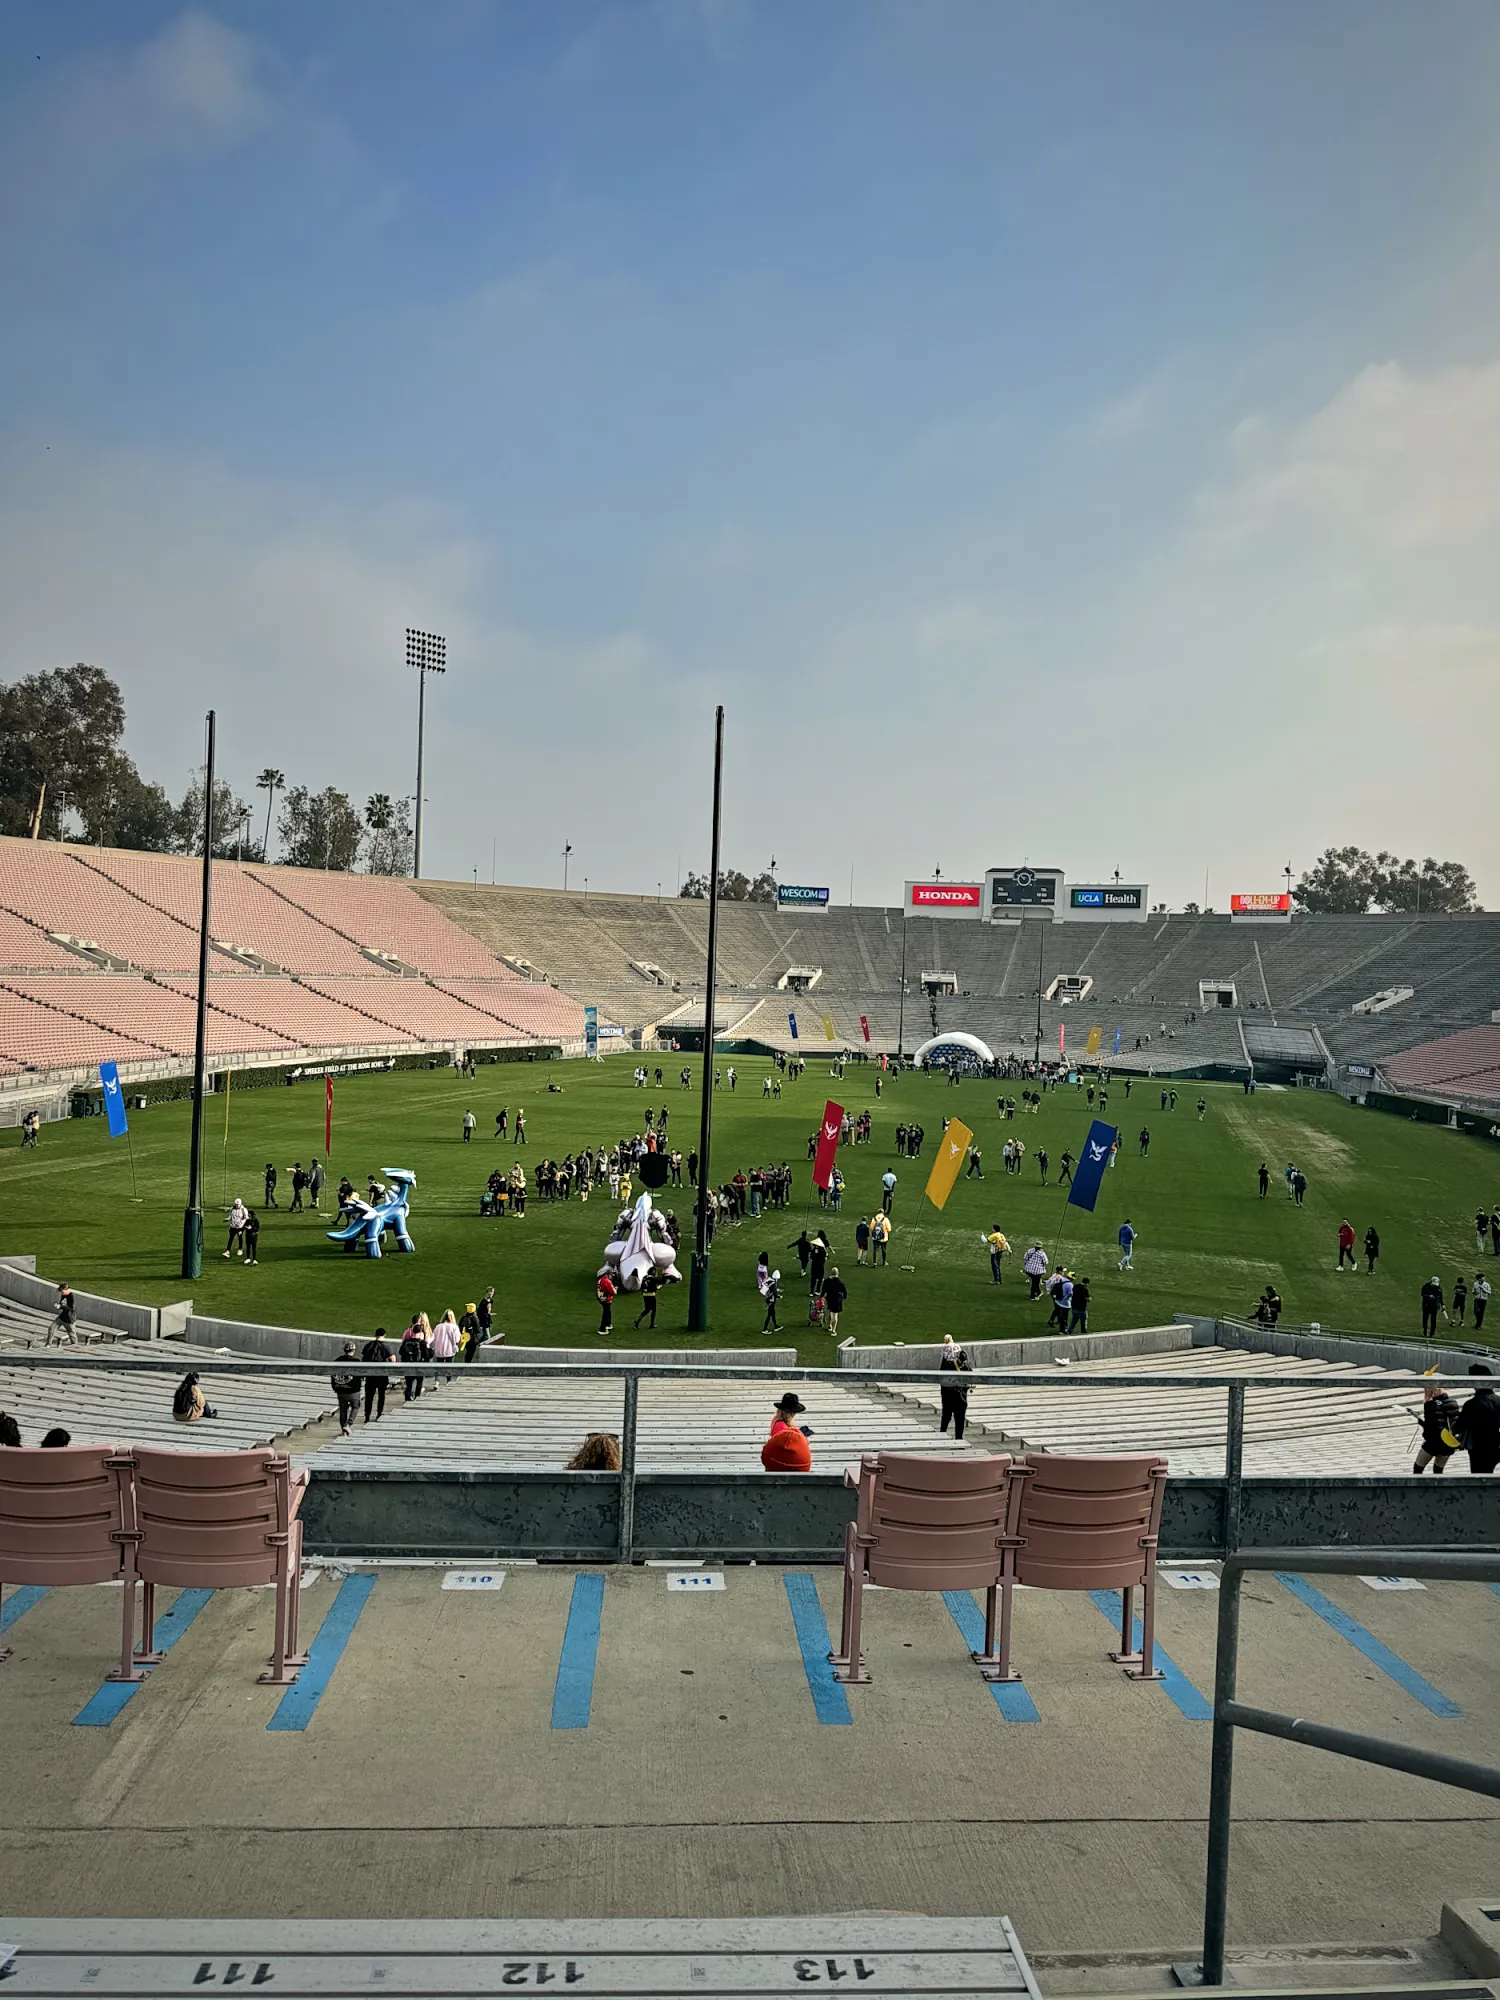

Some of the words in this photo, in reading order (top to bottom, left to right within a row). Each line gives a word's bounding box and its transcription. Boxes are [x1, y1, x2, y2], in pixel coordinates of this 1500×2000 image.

[780, 888, 818, 898] WESCOM
[918, 891, 974, 901] HONDA
[1078, 894, 1100, 903] UCLA
[1104, 893, 1137, 904] Health
[192, 1962, 275, 1985] 111
[501, 1961, 585, 1985] 112
[793, 1958, 875, 1982] 113
